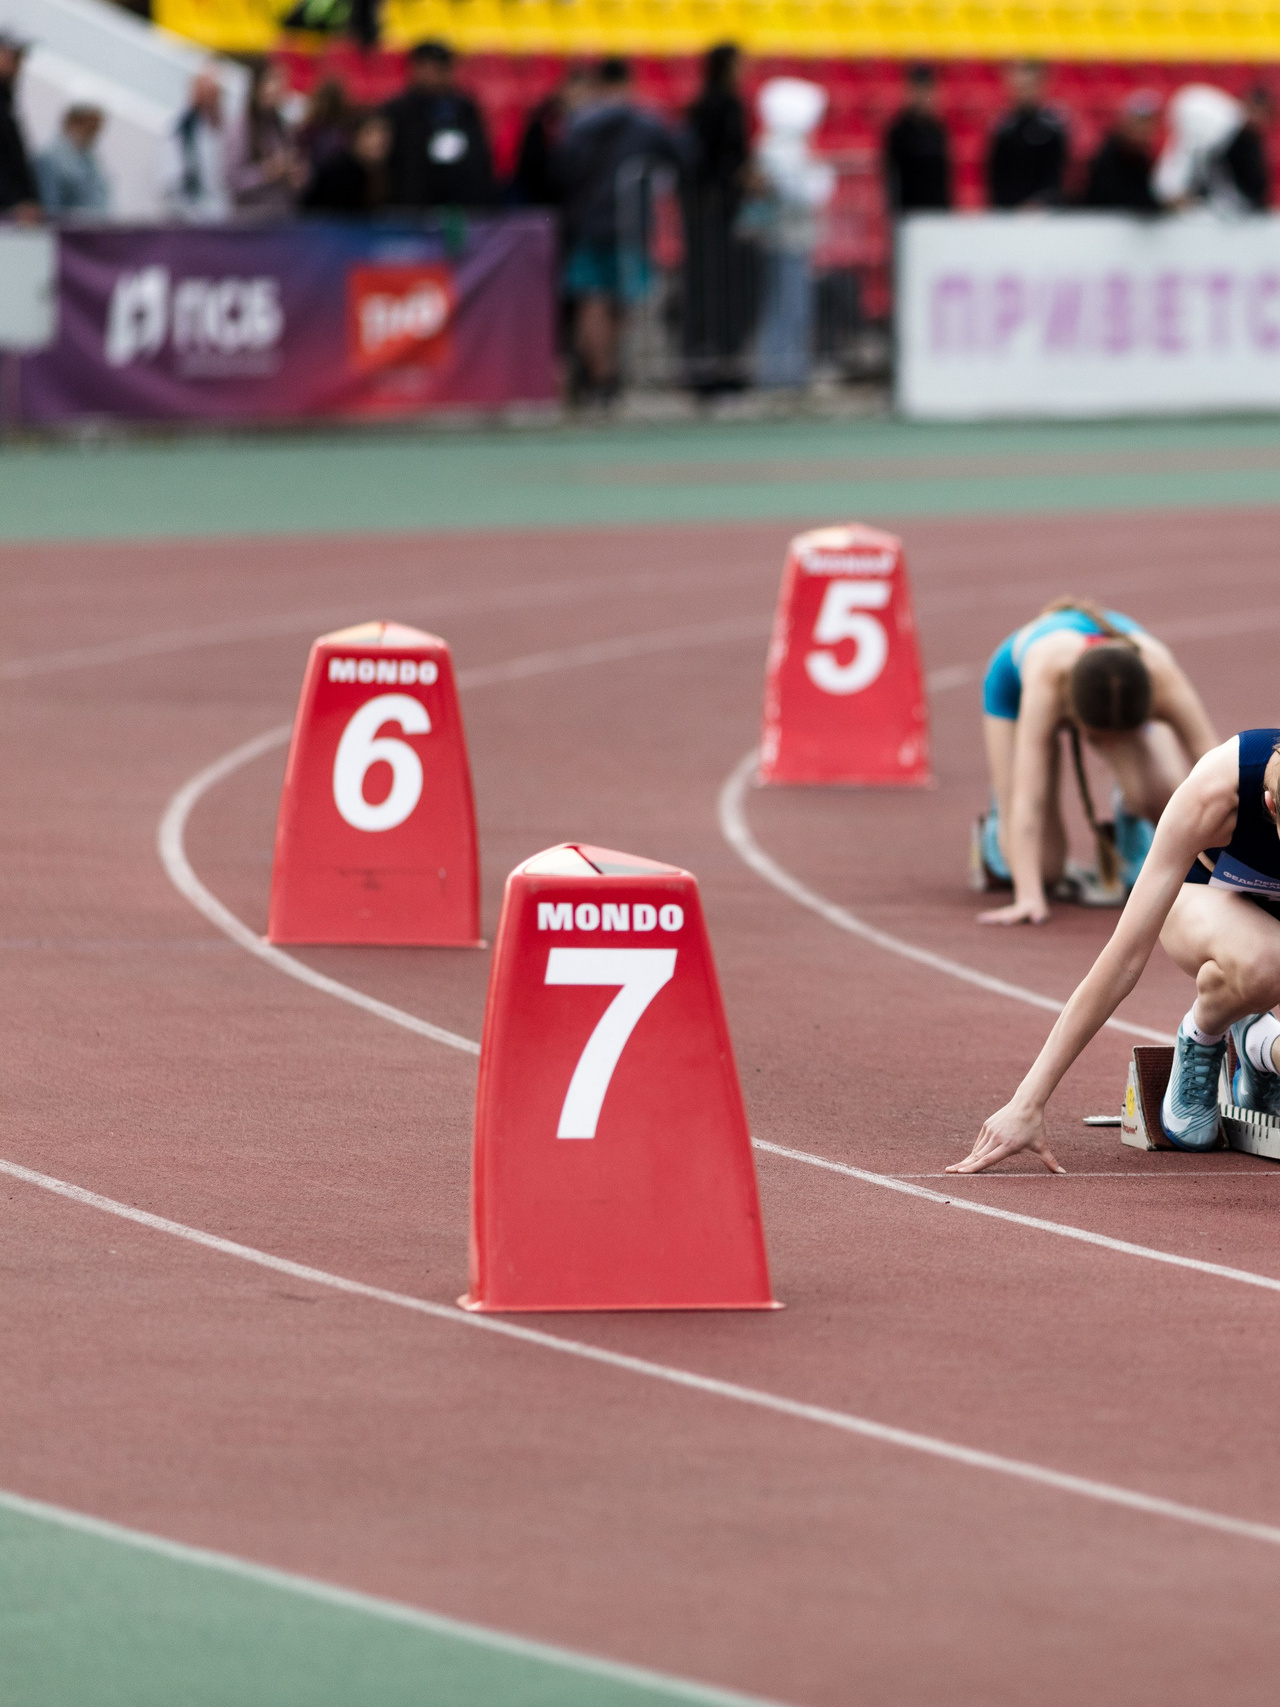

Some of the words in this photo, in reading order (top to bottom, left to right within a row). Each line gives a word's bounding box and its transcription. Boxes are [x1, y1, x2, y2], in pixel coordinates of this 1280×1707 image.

[328, 657, 438, 685] MONDO
[804, 578, 892, 696] 5
[332, 692, 432, 833] 6
[537, 902, 685, 932] MONDO
[543, 947, 678, 1140] 7
